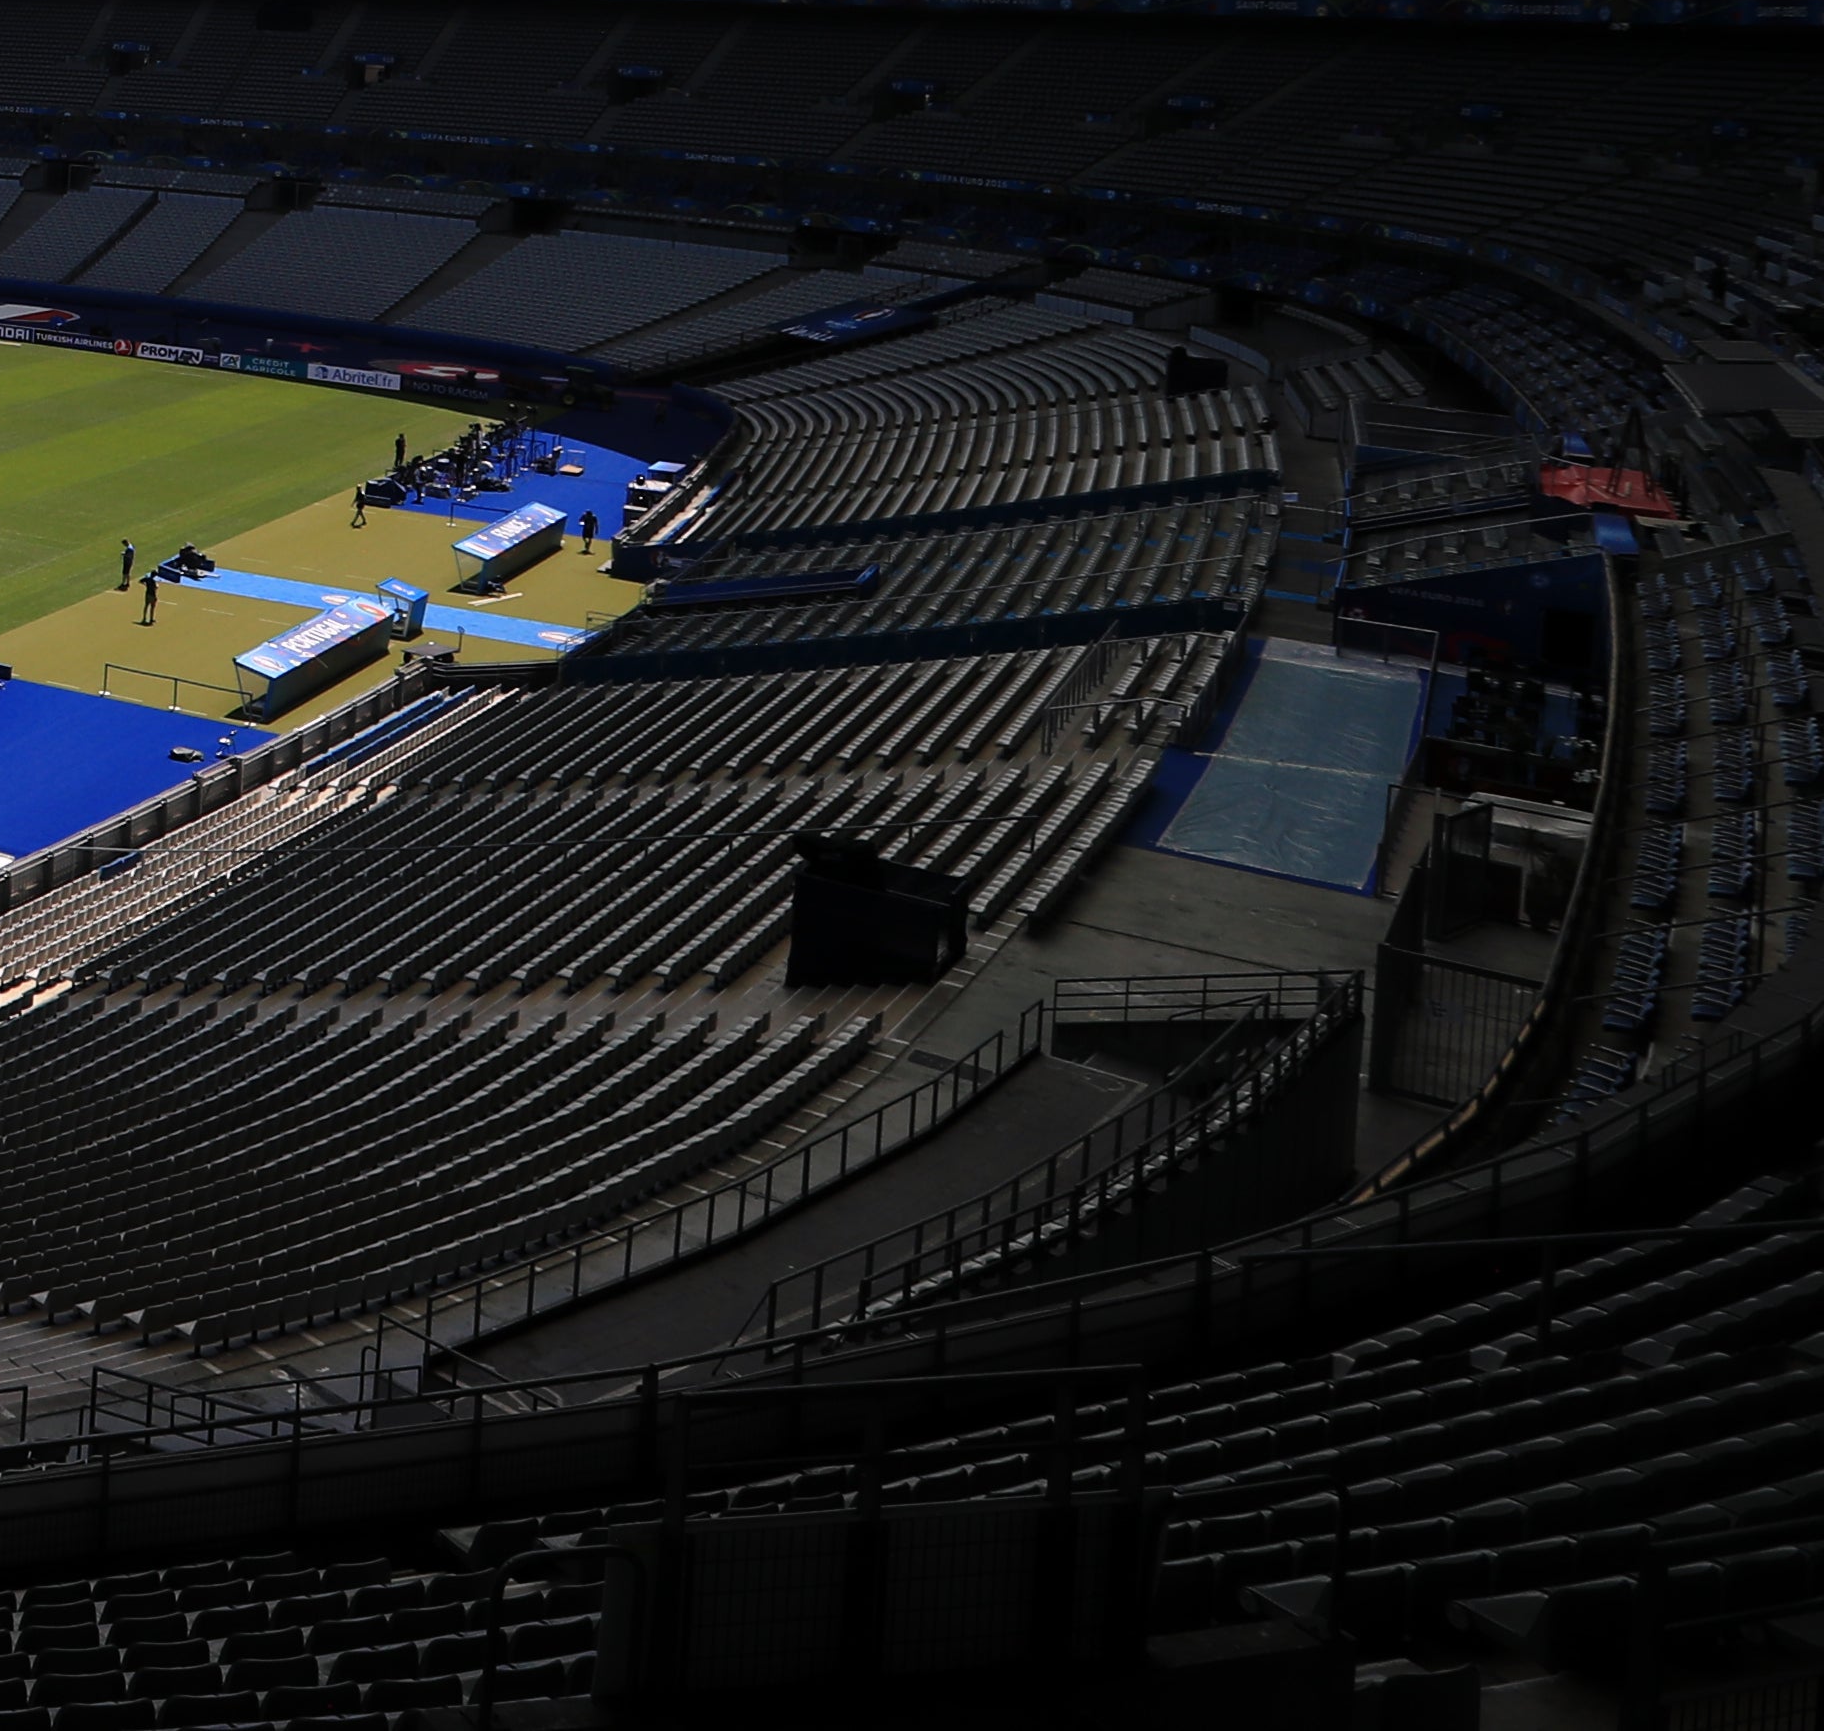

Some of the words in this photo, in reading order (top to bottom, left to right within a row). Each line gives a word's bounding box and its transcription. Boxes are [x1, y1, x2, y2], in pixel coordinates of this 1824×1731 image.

[35, 331, 74, 346] TURKISH
[74, 336, 114, 351] AIRLINES
[244, 364, 297, 378] AGRICOLE
[331, 367, 393, 392] Abritel.fr
[413, 380, 430, 392] NO
[431, 382, 447, 394] TO
[447, 383, 489, 400] RACISM
[280, 618, 351, 655] PORTUGAL
